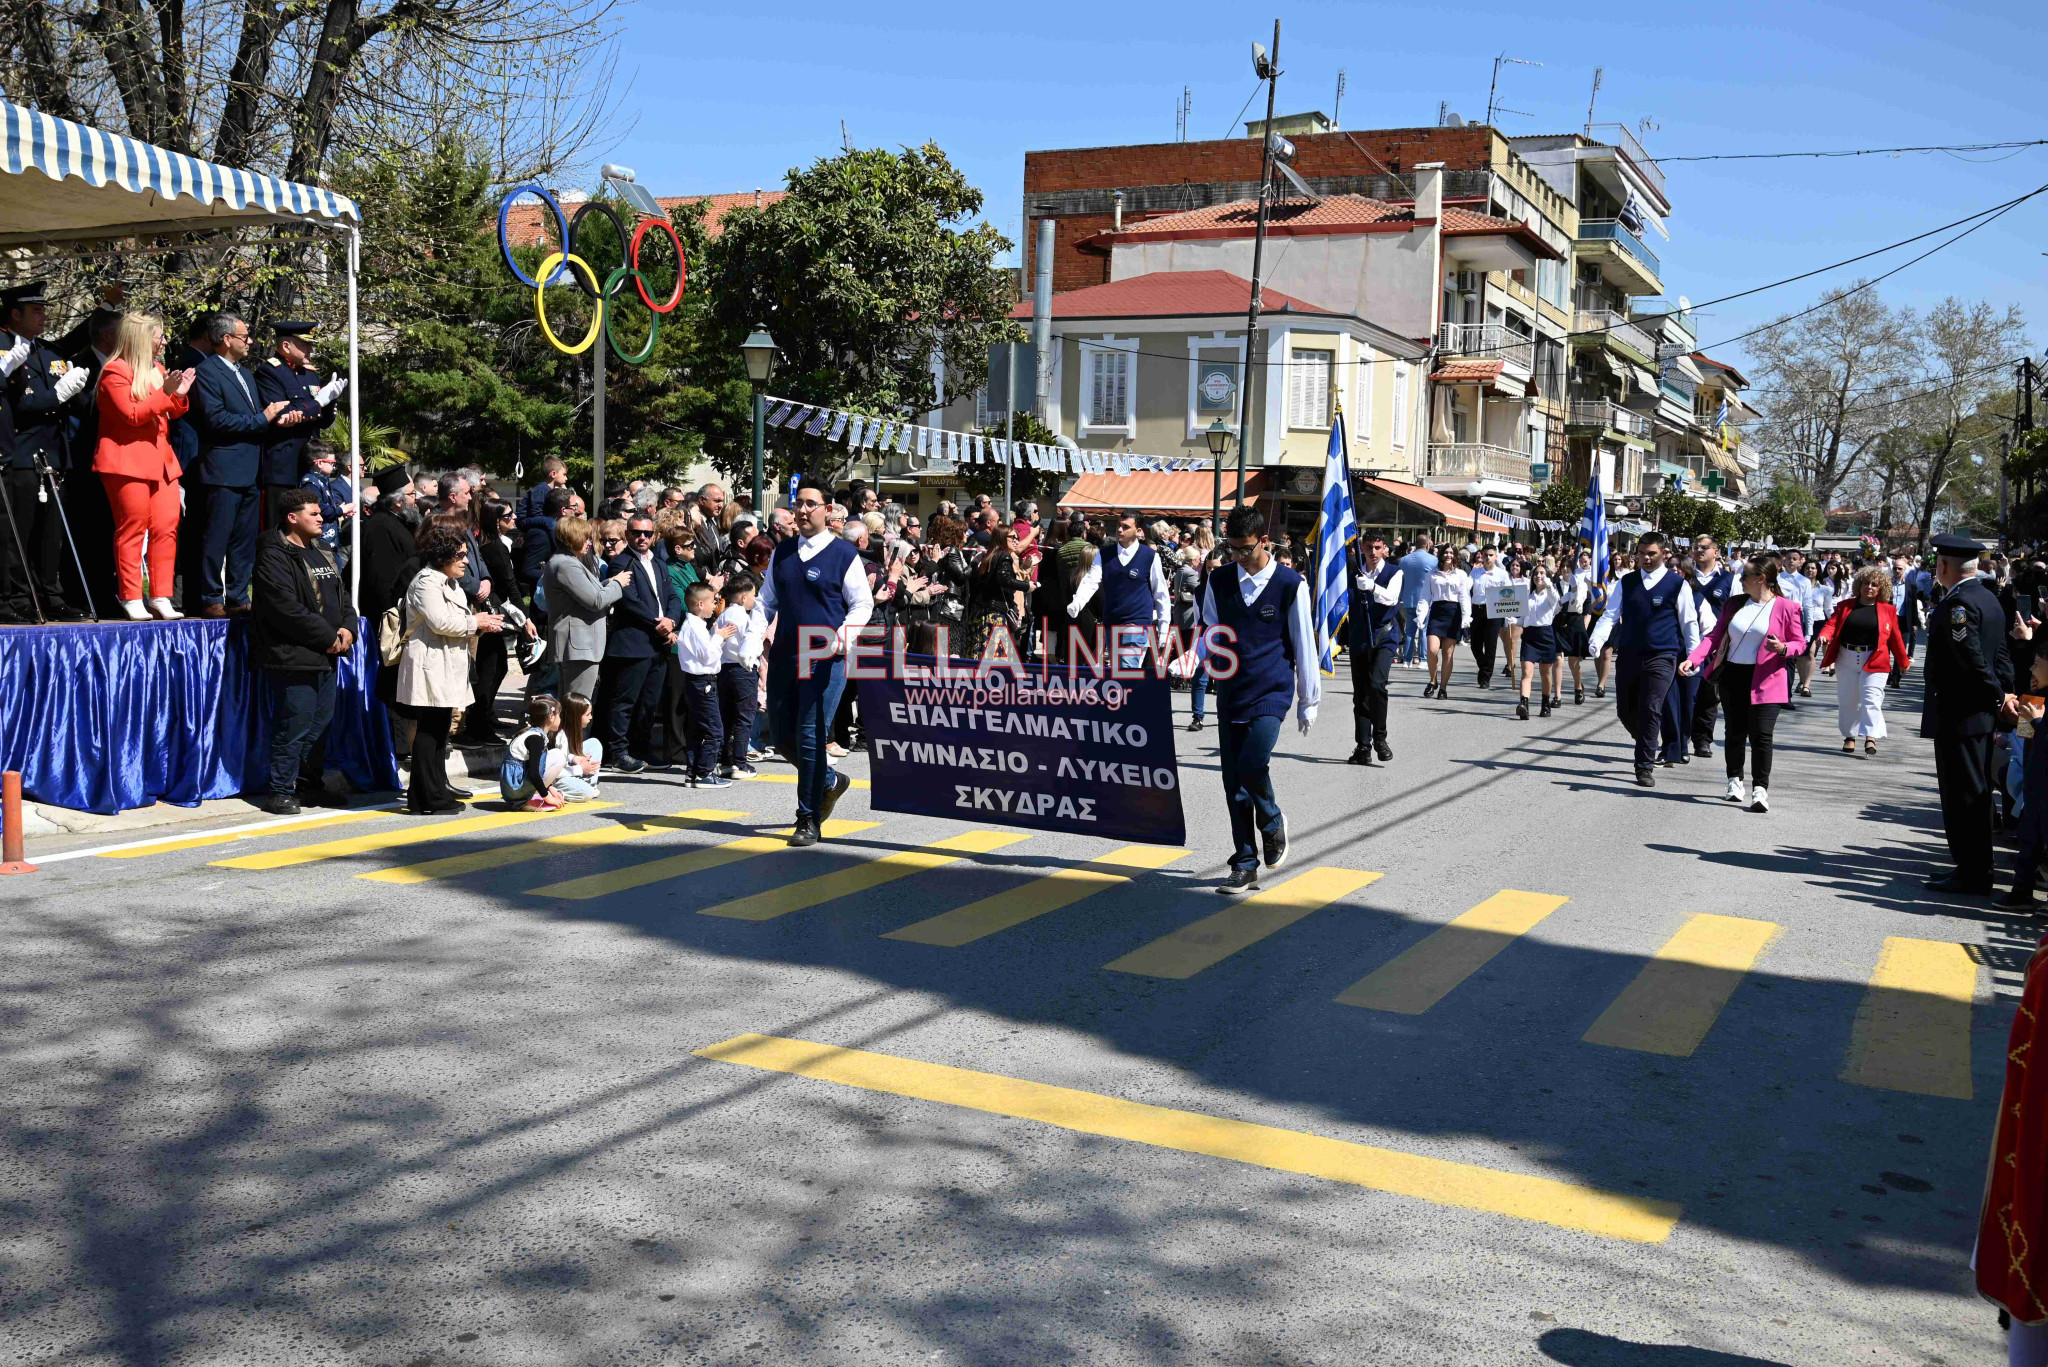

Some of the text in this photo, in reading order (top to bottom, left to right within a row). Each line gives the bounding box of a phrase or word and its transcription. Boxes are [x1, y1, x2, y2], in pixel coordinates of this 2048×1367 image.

[926, 476, 959, 487] Ρολόγια
[902, 664, 1124, 702] ΕΝΙΑΙΟ ΕΙΔΙΚΟ
[889, 702, 1148, 748] ΕΠΑΓΓΕΛΜΑΤΙΚΟ
[874, 738, 1029, 774] ΓΥΜΝΑΣΙΟ
[1057, 757, 1176, 790] ΛΥΚΕΙΟ
[954, 784, 1098, 822] ΣΚΥΔΡΑΣ
